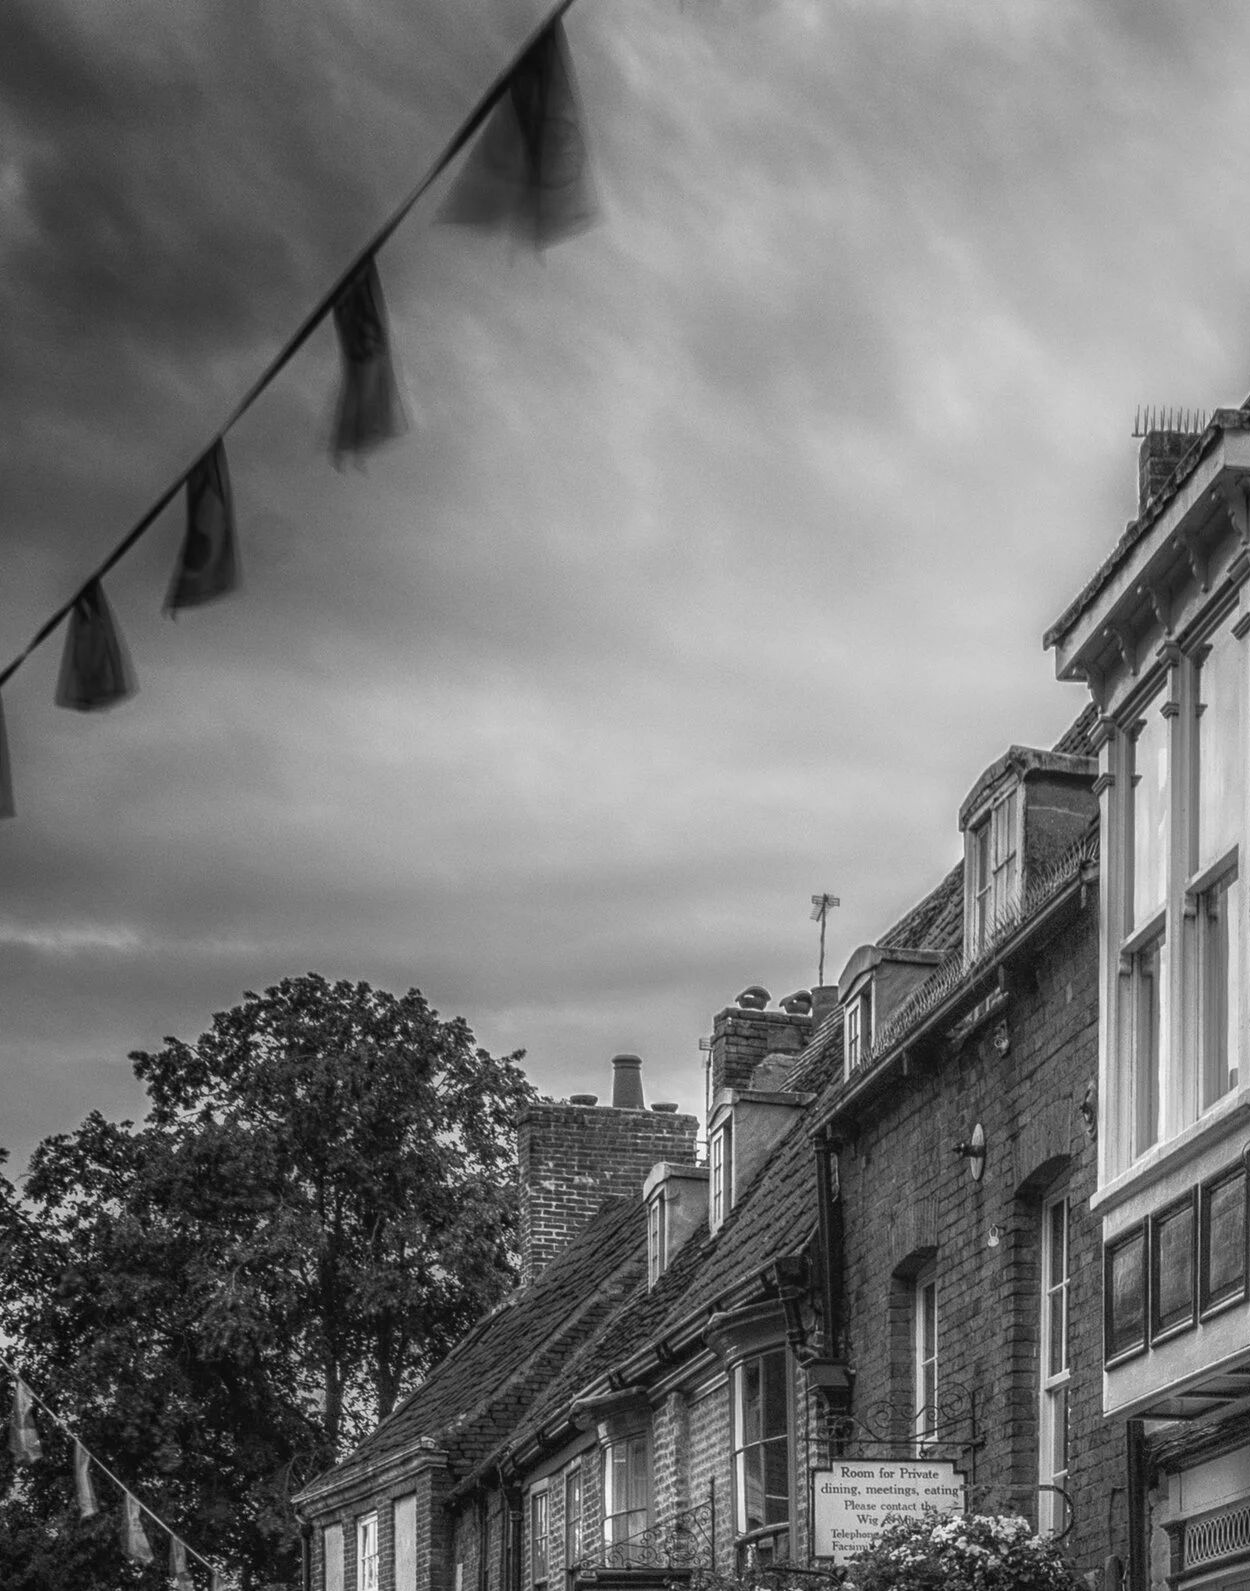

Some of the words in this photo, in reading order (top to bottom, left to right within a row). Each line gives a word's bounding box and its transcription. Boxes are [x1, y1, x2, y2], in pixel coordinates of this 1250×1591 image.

[840, 1467, 875, 1479] Room
[879, 1467, 895, 1479] for
[900, 1467, 939, 1479] Private
[821, 1483, 861, 1496] dining,
[866, 1484, 920, 1497] meetings,
[924, 1486, 959, 1497] eating
[844, 1500, 876, 1511] Please
[880, 1501, 916, 1511] contact
[921, 1500, 937, 1511] the
[856, 1514, 879, 1527] Wig
